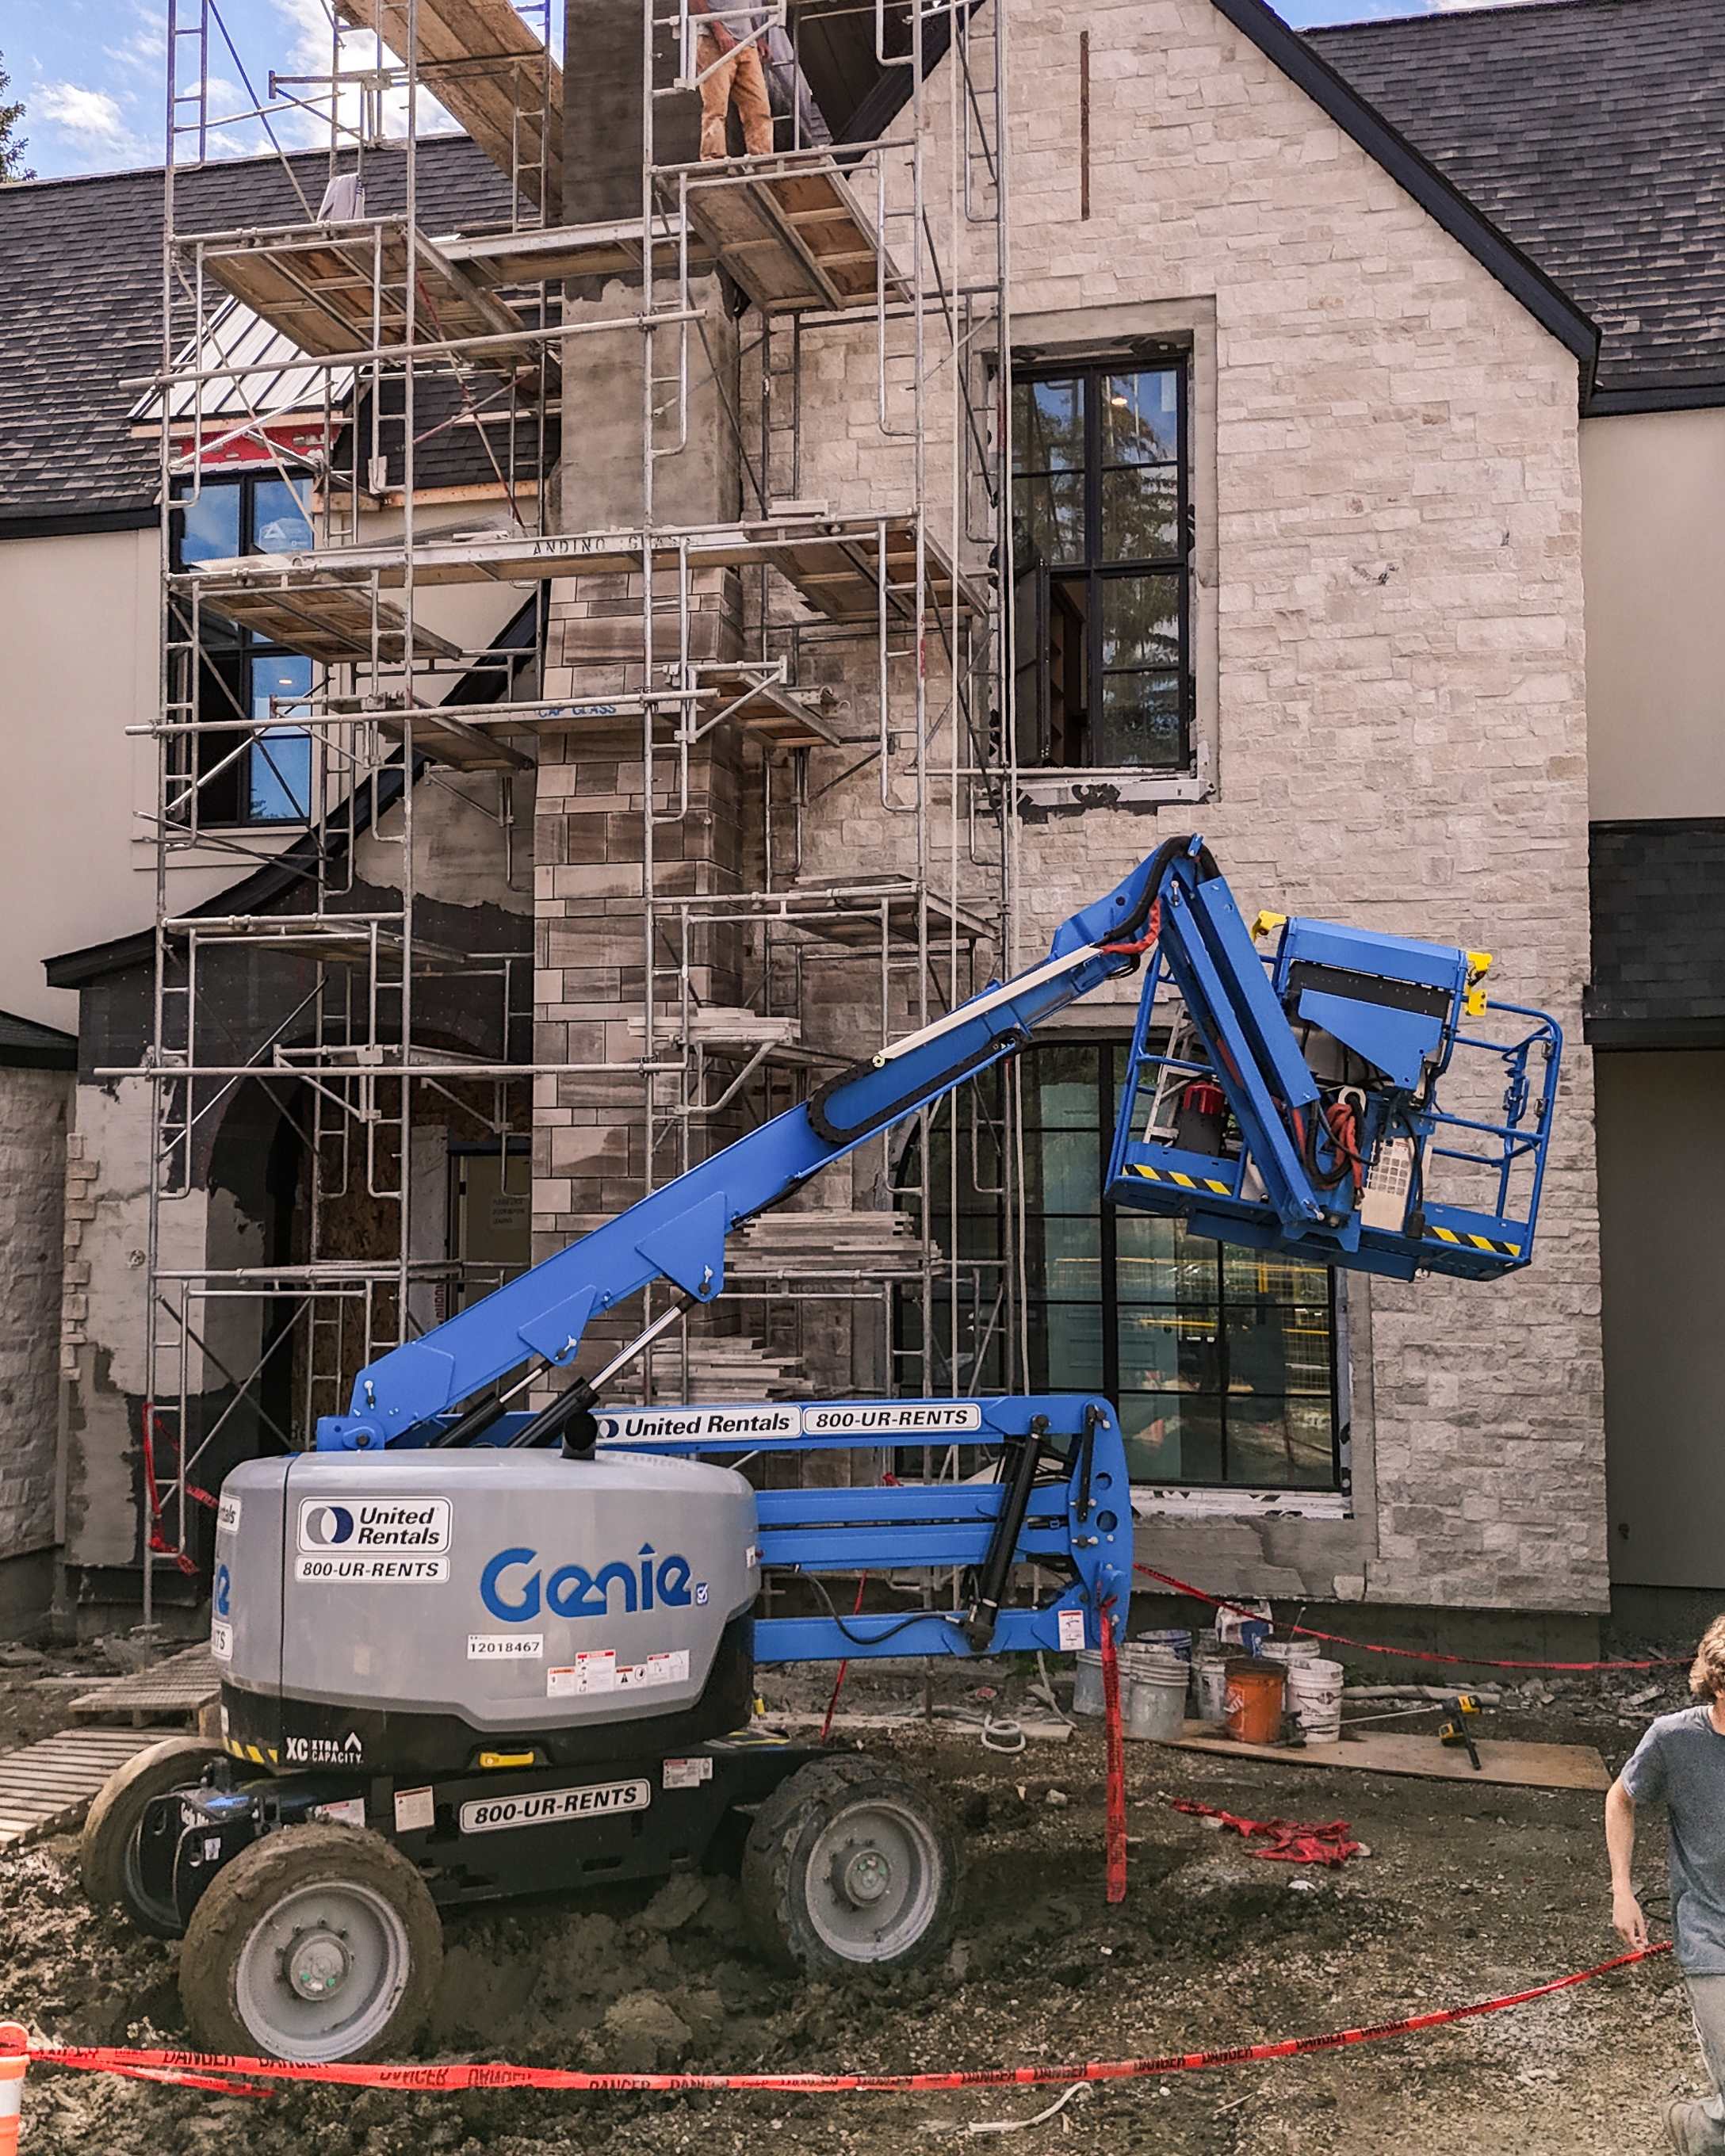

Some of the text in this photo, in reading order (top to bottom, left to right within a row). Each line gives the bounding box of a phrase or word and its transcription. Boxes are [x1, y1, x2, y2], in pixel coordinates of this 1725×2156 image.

[533, 538, 606, 555] ANDINO
[625, 1412, 790, 1436] United Rentals
[816, 1409, 968, 1428] 800-UR-RENTS
[360, 1507, 435, 1524] United
[358, 1527, 441, 1545] Rentals
[303, 1562, 439, 1577] 800-UR-RENTS
[480, 1542, 692, 1623] Genie
[471, 1642, 540, 1653] 12018467
[286, 1737, 308, 1761] XC
[312, 1740, 338, 1752] XTRA
[312, 1751, 362, 1764] CAPACITY
[475, 1786, 637, 1825] 800-UR-RENTS
[163, 2049, 235, 2066] DANGER
